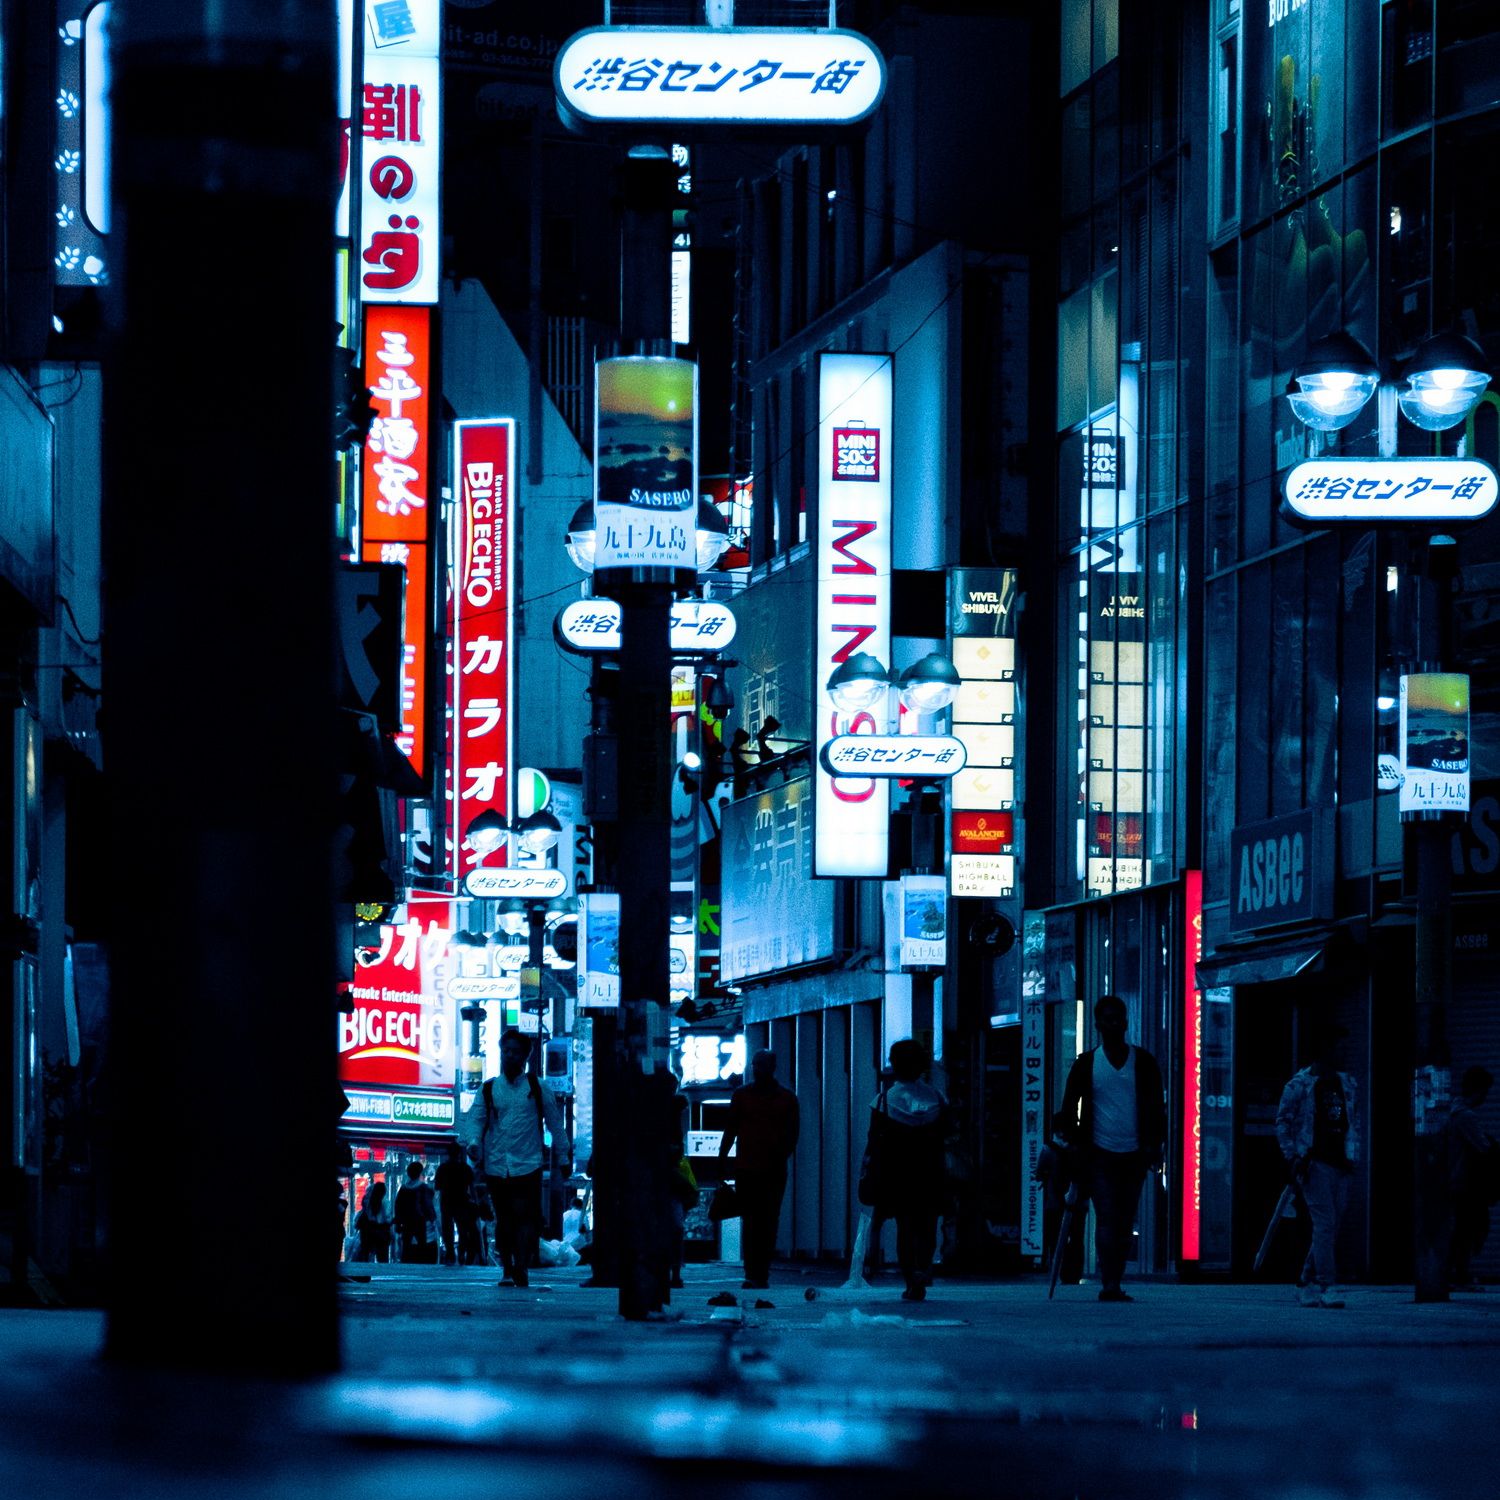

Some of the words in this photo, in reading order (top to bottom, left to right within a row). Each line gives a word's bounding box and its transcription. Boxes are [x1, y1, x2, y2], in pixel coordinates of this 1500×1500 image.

[444, 23, 559, 56] it-ad.co.jp
[573, 57, 865, 94] 渋谷センター街
[363, 83, 423, 290] 靴のダ
[838, 434, 876, 449] MINI
[466, 462, 494, 518] BIG
[494, 474, 504, 515] Karaoke
[629, 488, 691, 506] SASEBO
[1296, 476, 1488, 500] 渋谷センター街
[604, 525, 686, 551] 九十九島
[466, 523, 493, 607] ECHO
[493, 518, 504, 591] Entertainment
[969, 592, 999, 602] VIVEL
[961, 602, 1007, 614] SHIBUYA
[834, 747, 957, 764] 渋谷センター街
[1431, 758, 1468, 771] SASEBO
[1412, 782, 1467, 800] 九十九島
[958, 861, 1000, 869] SHIBUYA
[471, 876, 561, 890] 渋谷センター街
[958, 873, 1007, 881] HIGHBALL
[339, 1007, 383, 1053] BIG
[385, 1010, 449, 1060] ECHO
